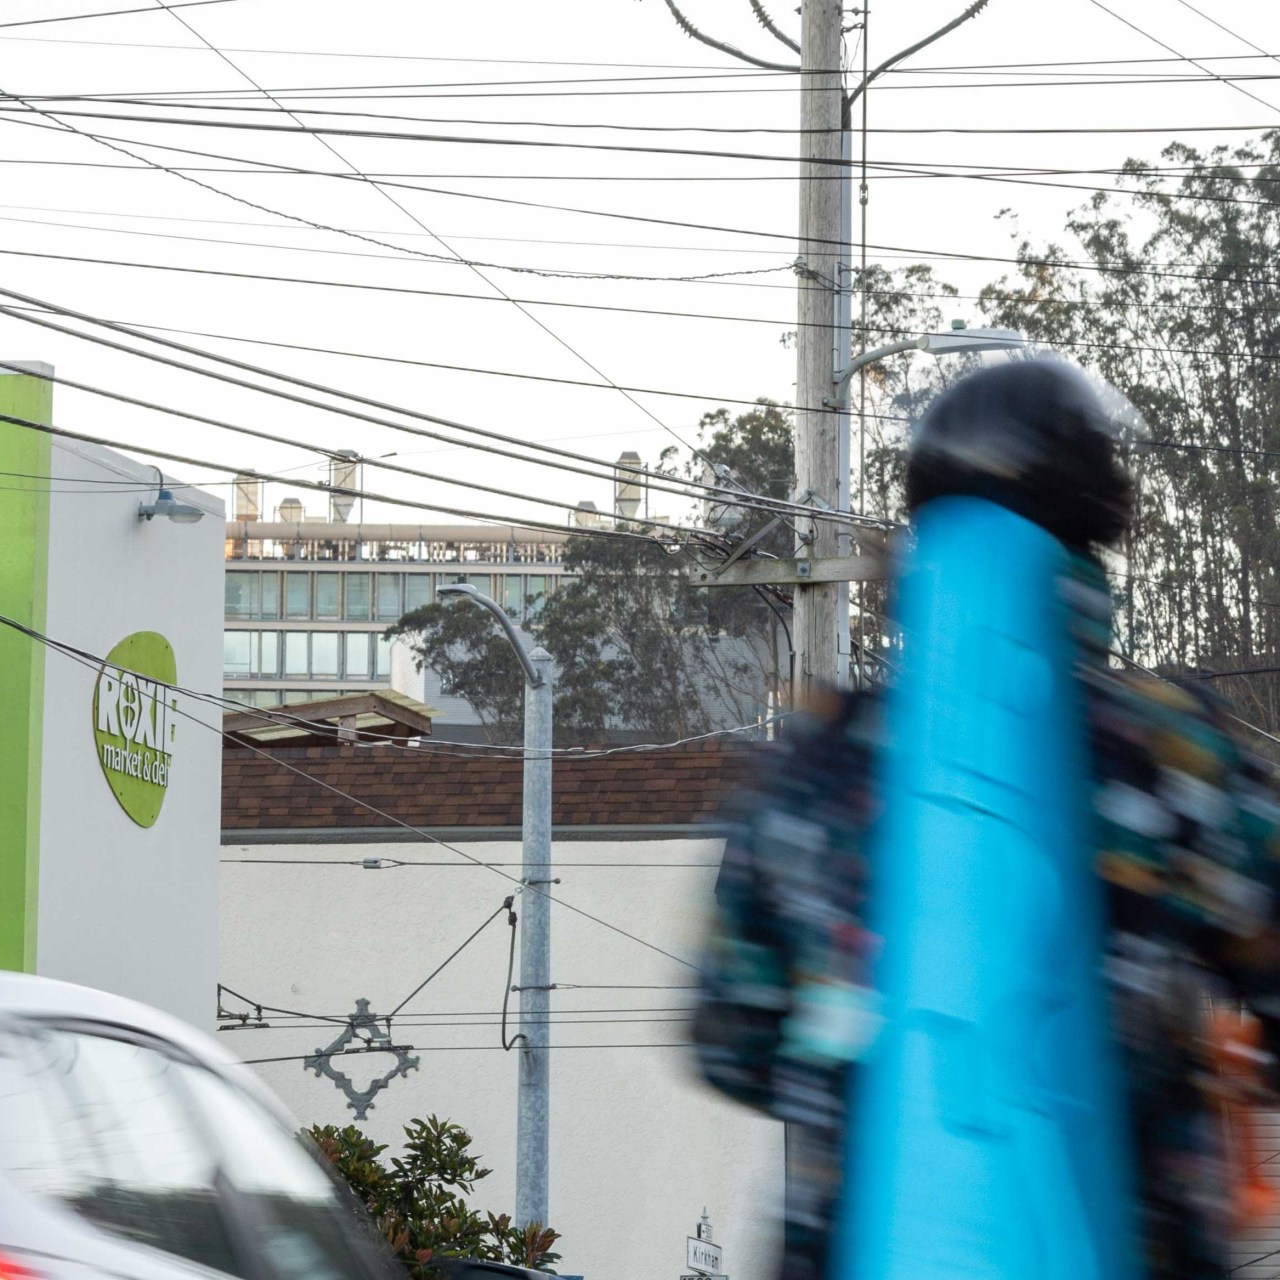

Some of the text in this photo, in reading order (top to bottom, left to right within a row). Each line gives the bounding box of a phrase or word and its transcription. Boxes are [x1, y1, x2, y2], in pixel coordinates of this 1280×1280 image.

[98, 666, 178, 753] ROXIE
[103, 743, 171, 788] market & deli
[693, 1245, 719, 1270] Kirkham
